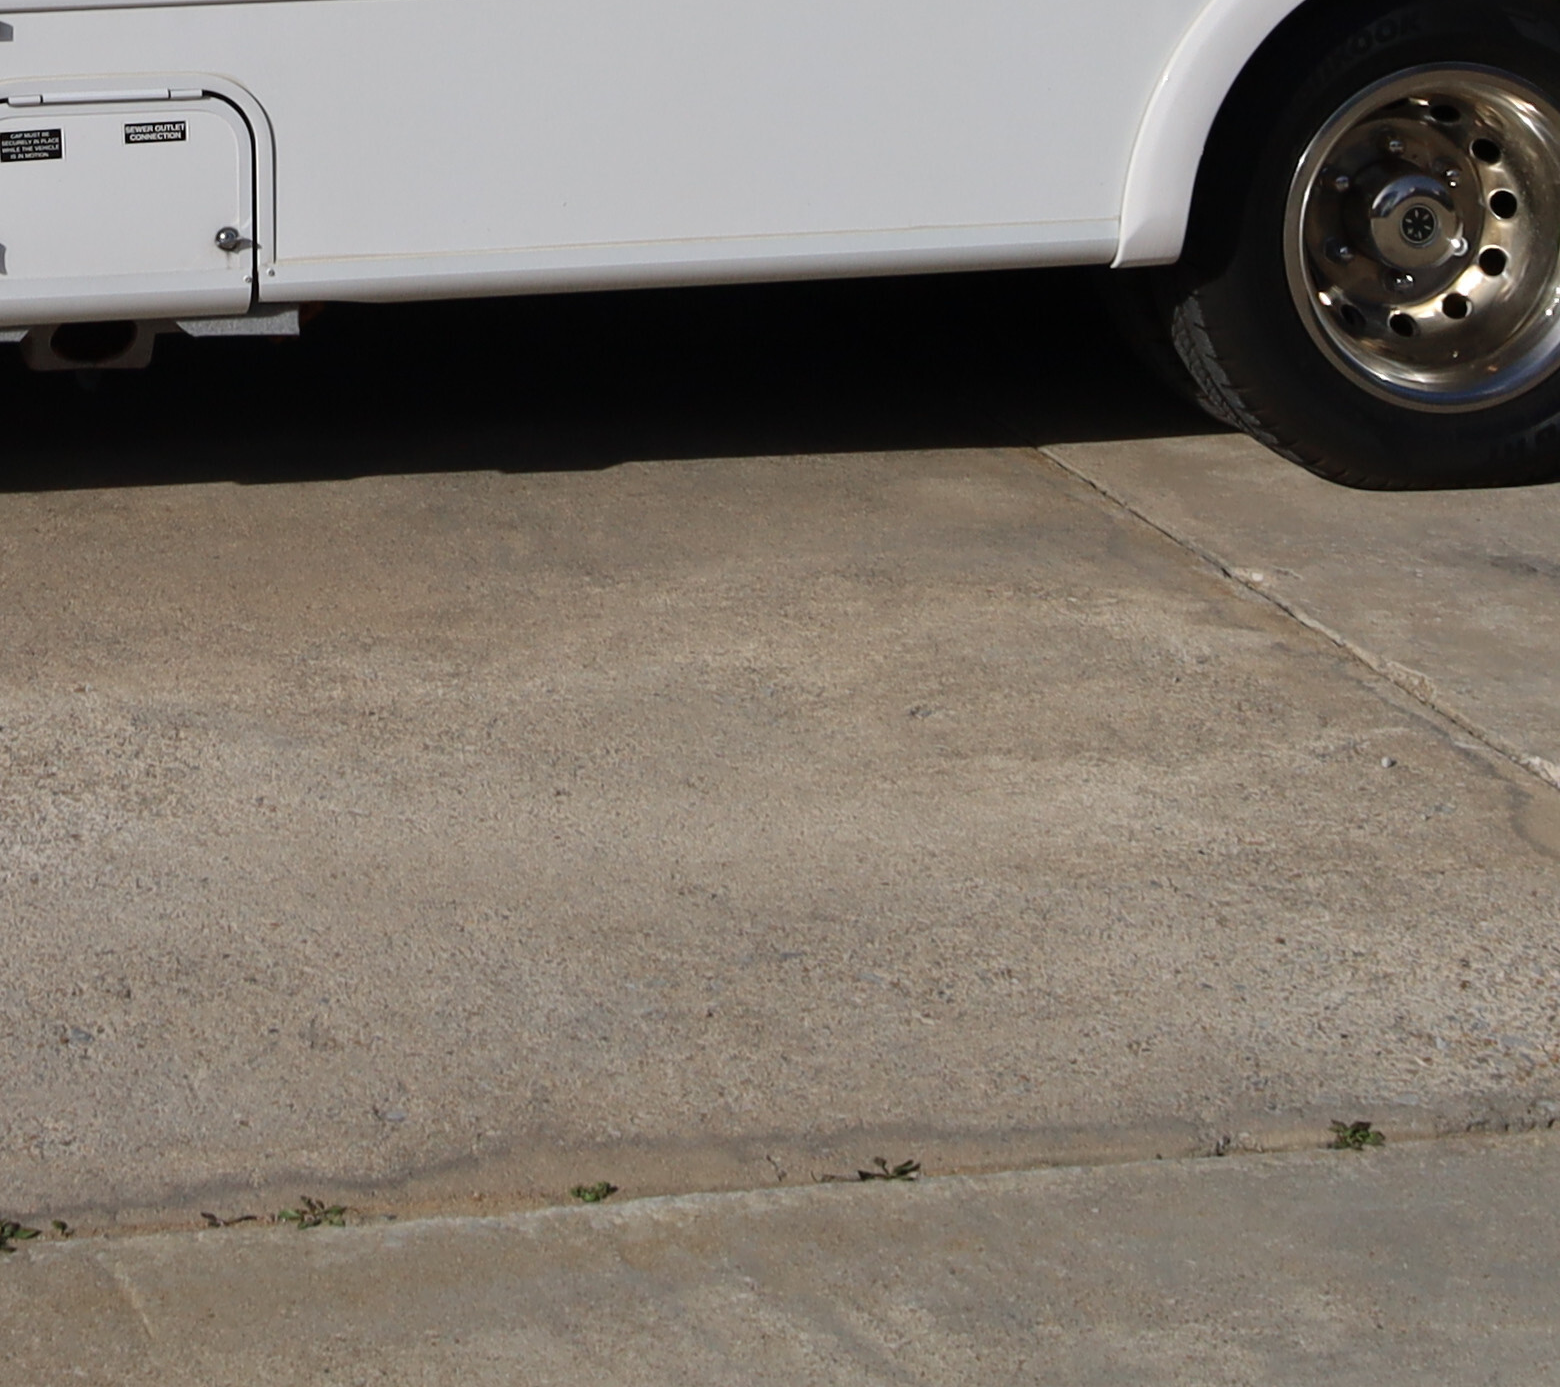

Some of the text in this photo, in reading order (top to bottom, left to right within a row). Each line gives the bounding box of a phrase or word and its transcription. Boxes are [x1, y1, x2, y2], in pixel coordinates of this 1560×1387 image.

[125, 123, 185, 134] SEWER OUTLET
[129, 131, 182, 142] CONNECTION
[1, 139, 32, 147] SECURELY
[1, 146, 20, 154] WHILE
[34, 144, 60, 152] VEHICLE
